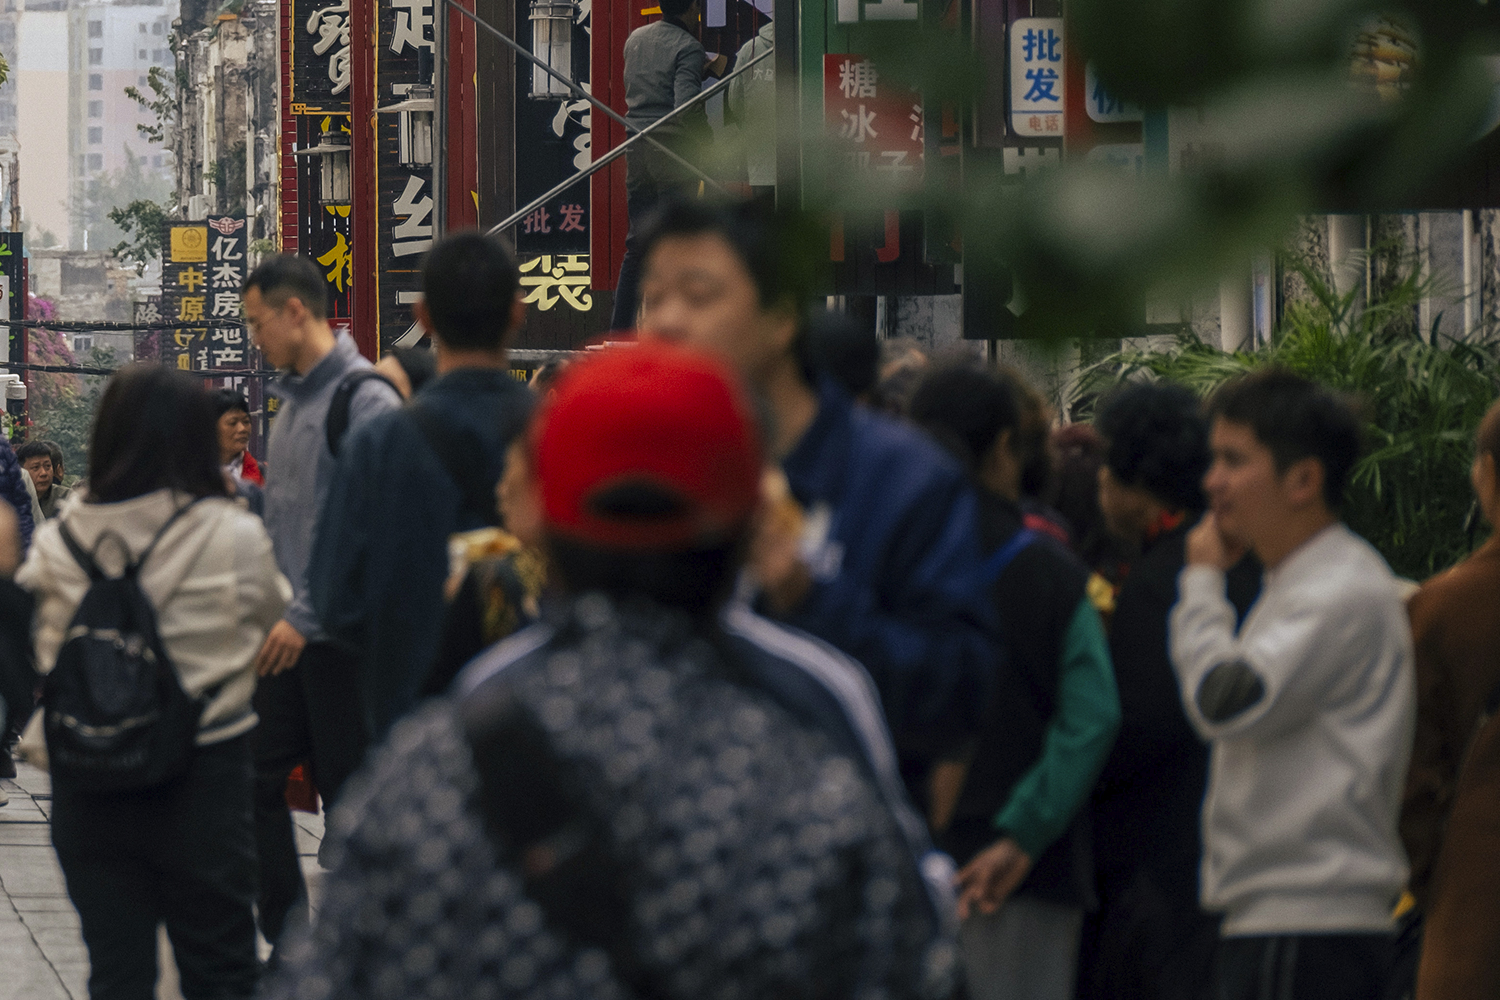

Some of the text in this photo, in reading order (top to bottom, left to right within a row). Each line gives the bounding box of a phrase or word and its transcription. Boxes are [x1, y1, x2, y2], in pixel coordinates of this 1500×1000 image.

[1022, 28, 1062, 103] 批发
[523, 204, 586, 234] 批发
[211, 236, 244, 367] 亿杰房地产
